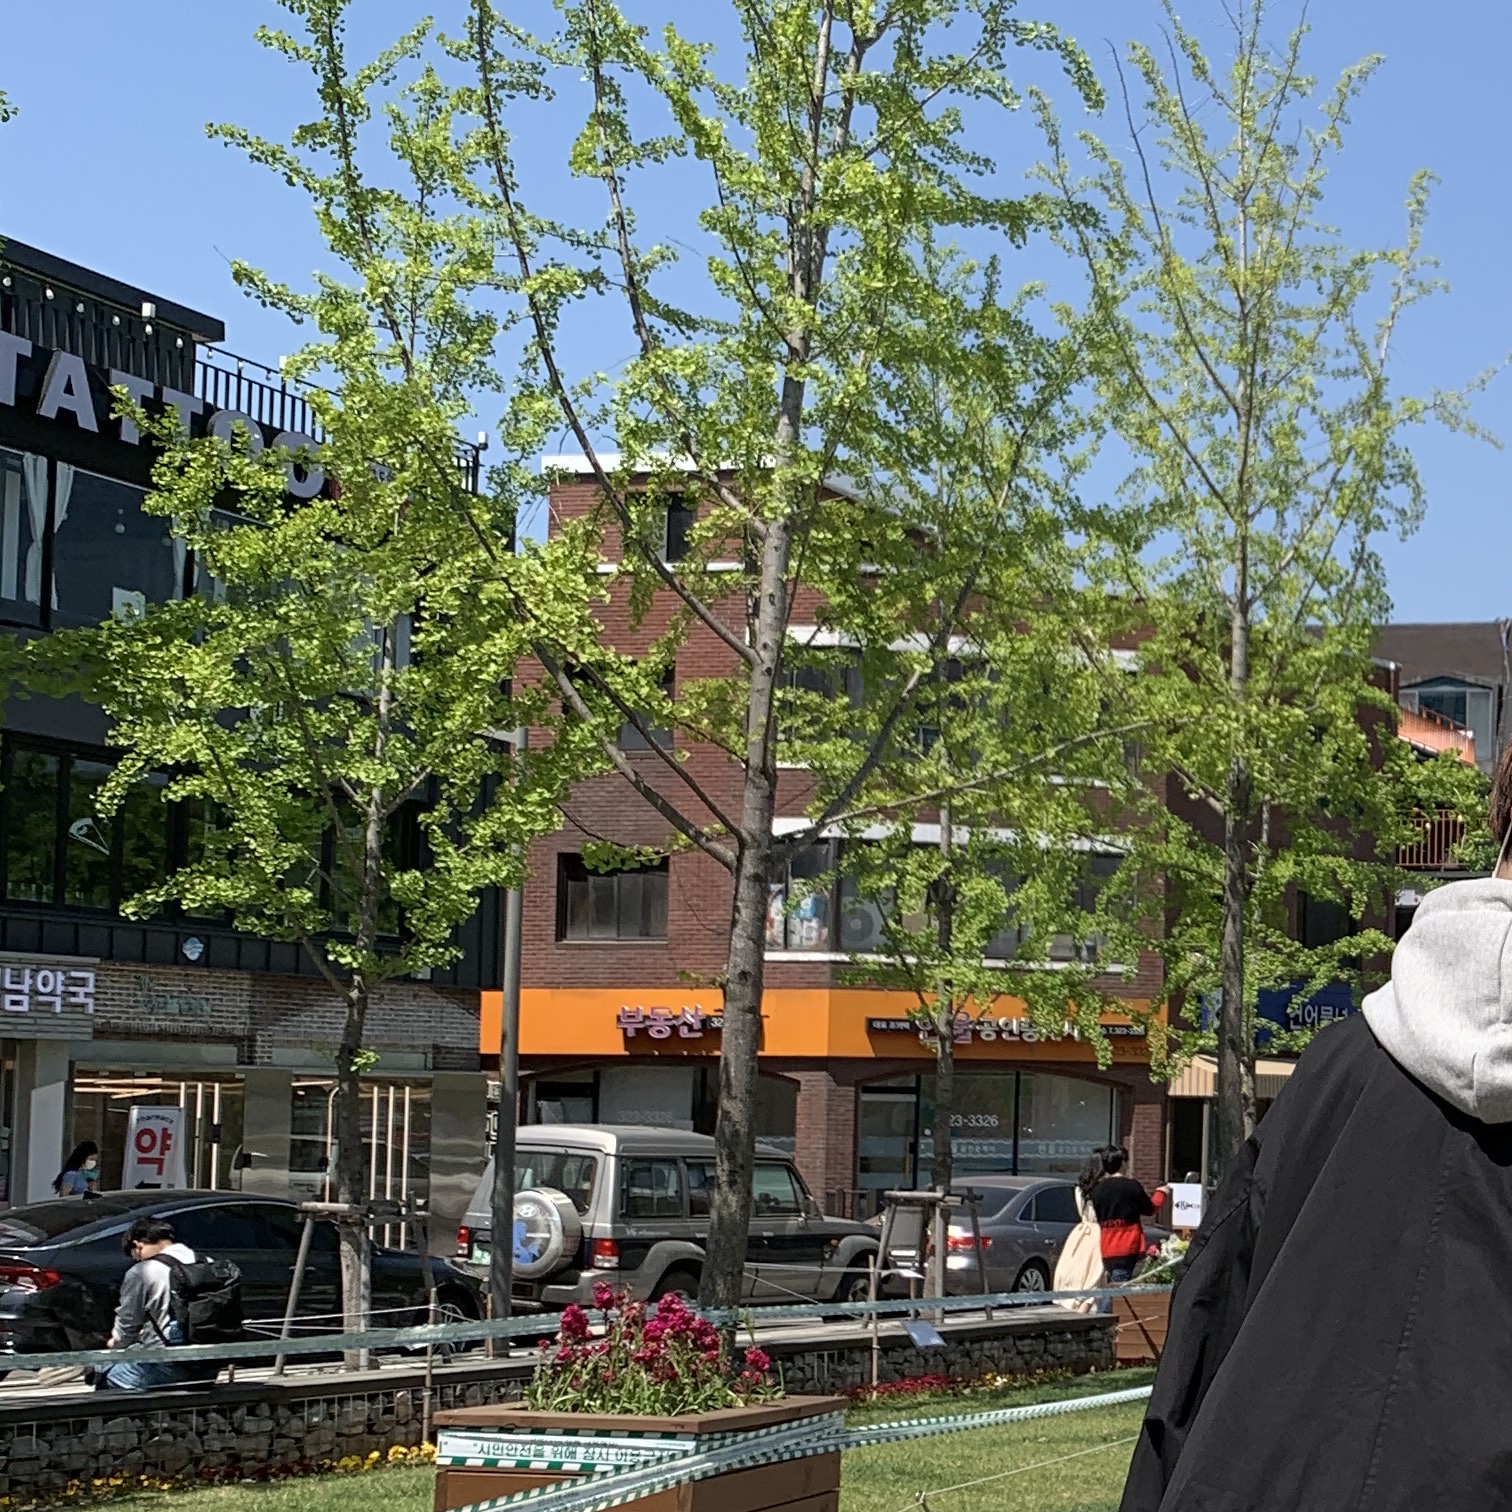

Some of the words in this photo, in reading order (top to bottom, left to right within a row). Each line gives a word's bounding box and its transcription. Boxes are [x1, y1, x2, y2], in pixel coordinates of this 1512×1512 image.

[0, 967, 95, 1014] 남약국
[617, 1005, 703, 1038] 부동산
[134, 1127, 173, 1177] 약
